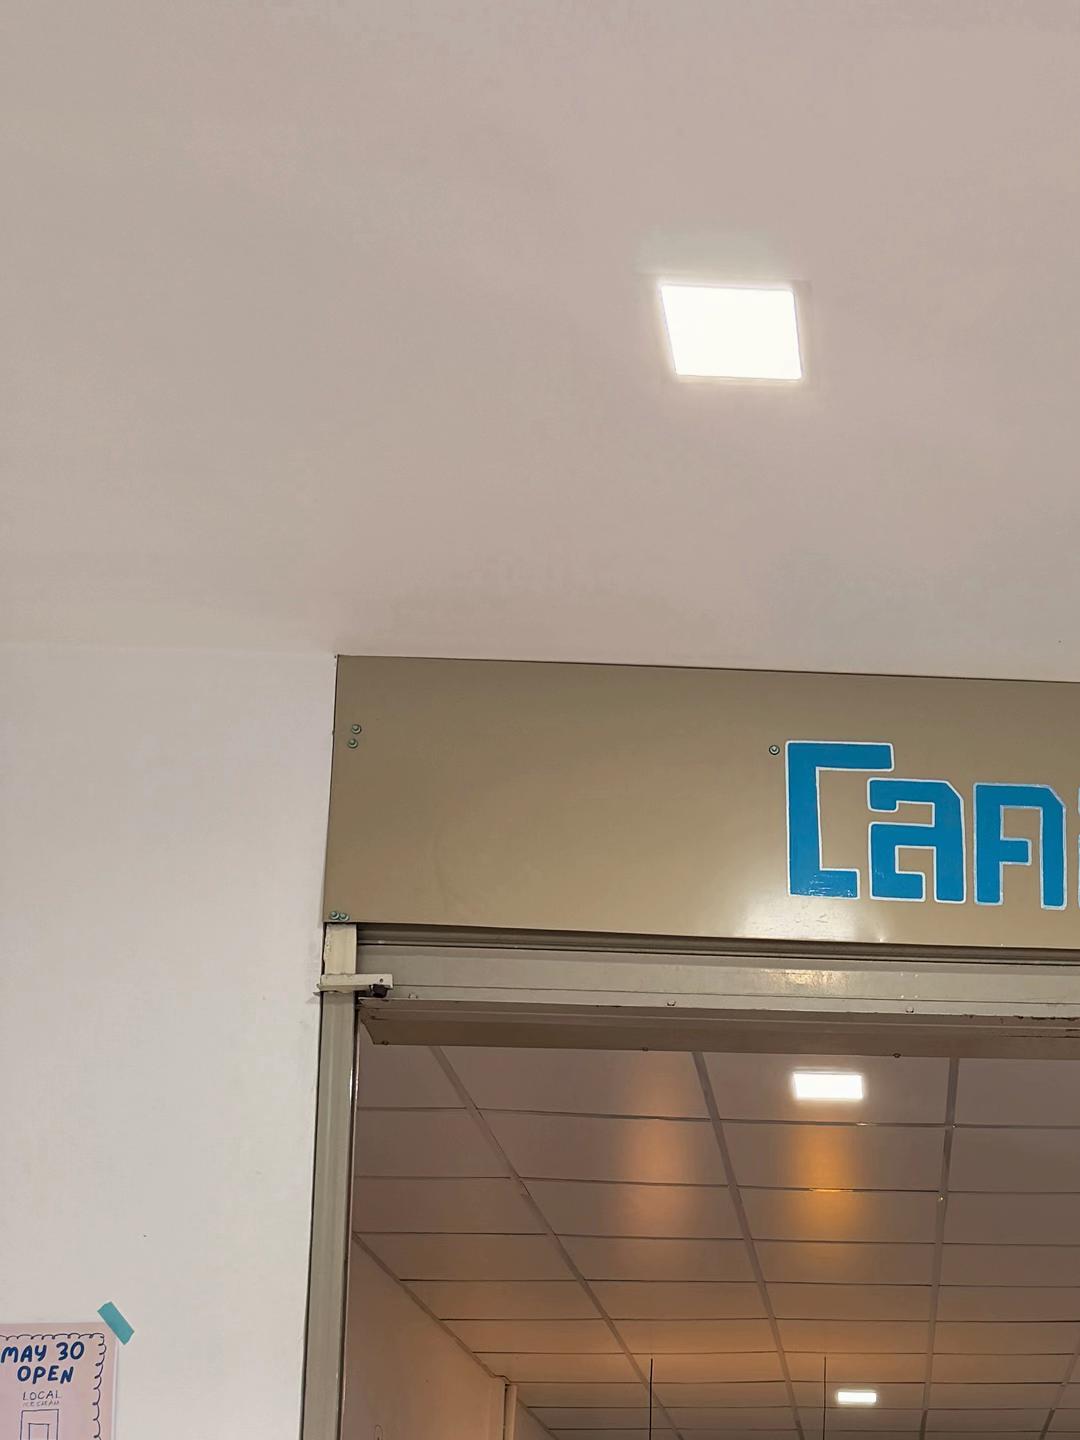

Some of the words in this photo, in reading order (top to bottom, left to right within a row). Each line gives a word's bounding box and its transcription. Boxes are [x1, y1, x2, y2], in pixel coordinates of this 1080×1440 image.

[0, 1344, 47, 1363] MAY
[56, 1341, 85, 1361] 30
[17, 1365, 74, 1385] OPEN
[22, 1390, 62, 1401] LOCAL
